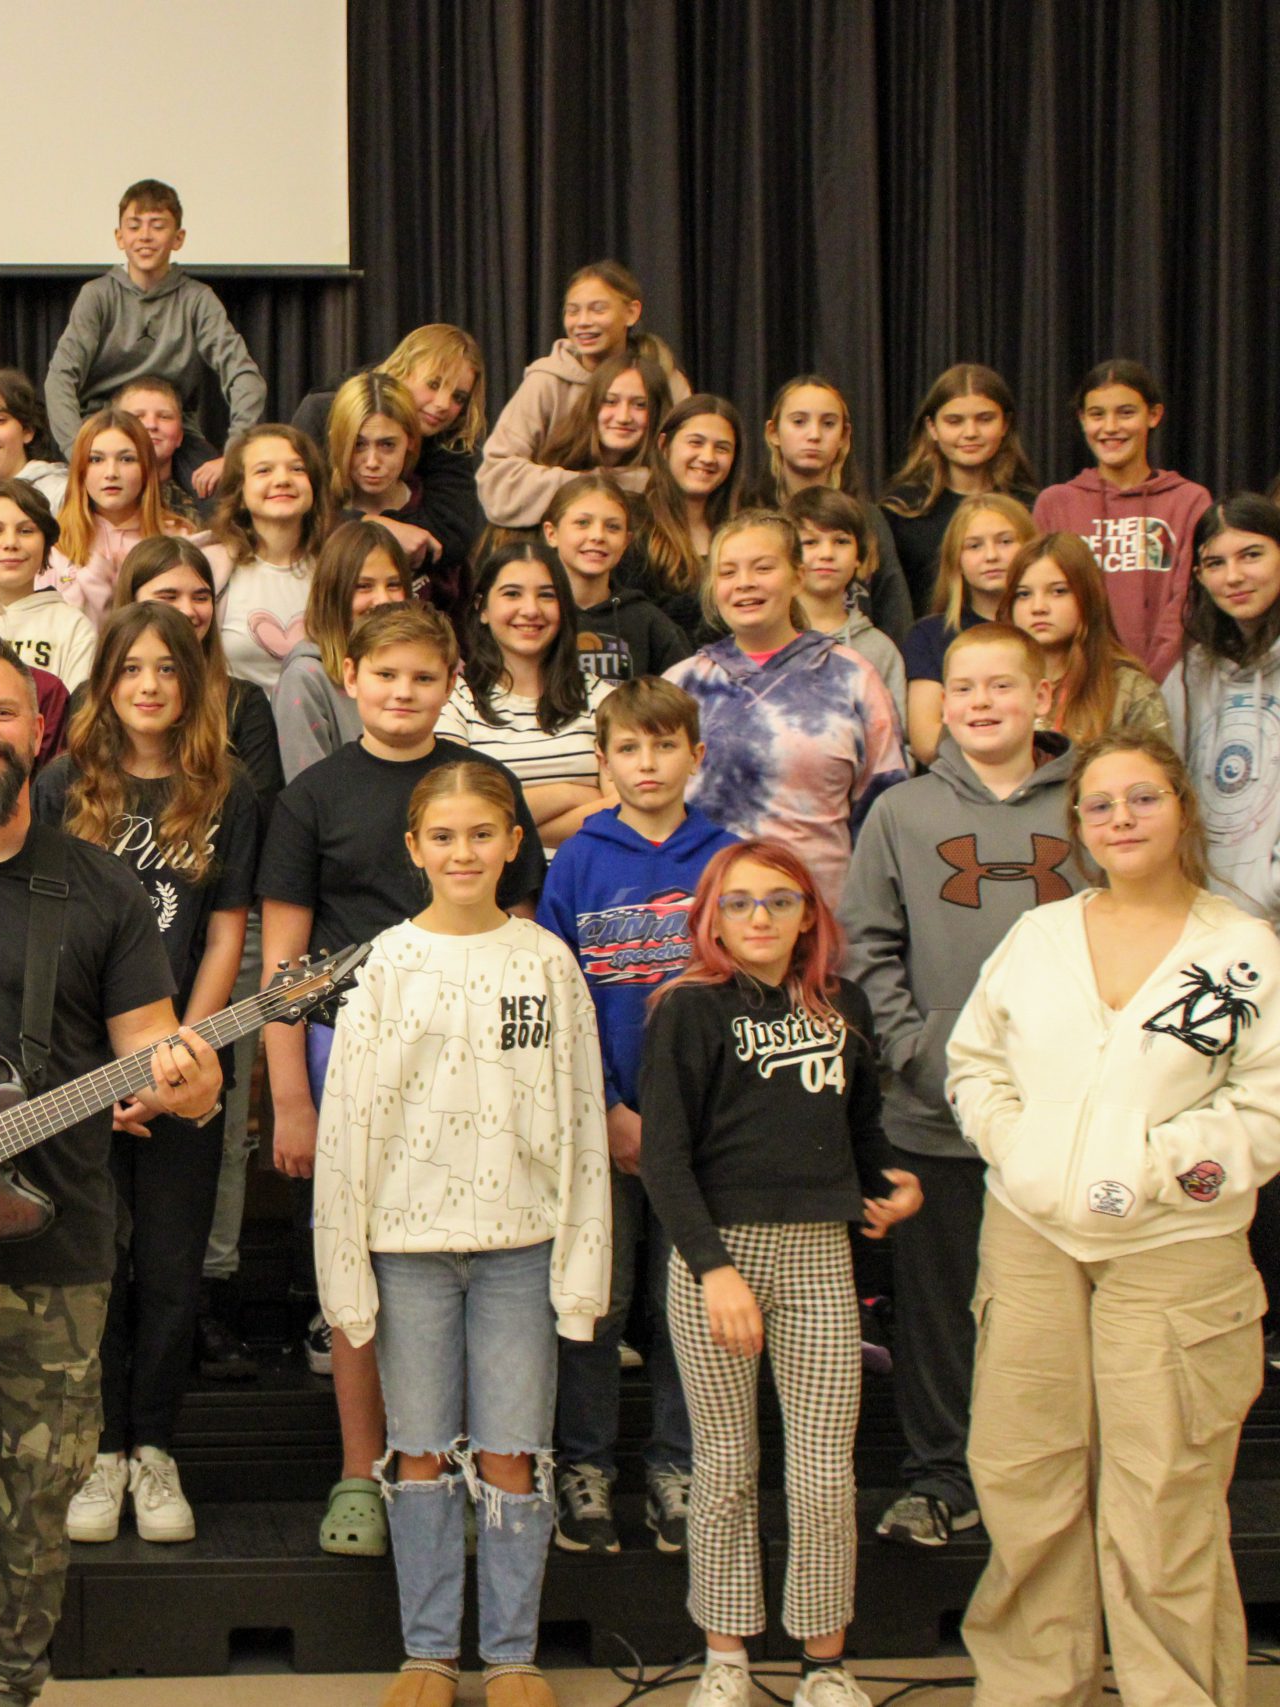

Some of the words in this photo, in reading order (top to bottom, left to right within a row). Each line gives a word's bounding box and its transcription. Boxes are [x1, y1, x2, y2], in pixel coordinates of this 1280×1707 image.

[1091, 516, 1138, 536] THE
[500, 994, 548, 1022] HEY
[501, 1020, 552, 1051] BOO!
[732, 1005, 847, 1062] Justice
[800, 1055, 847, 1095] 04
